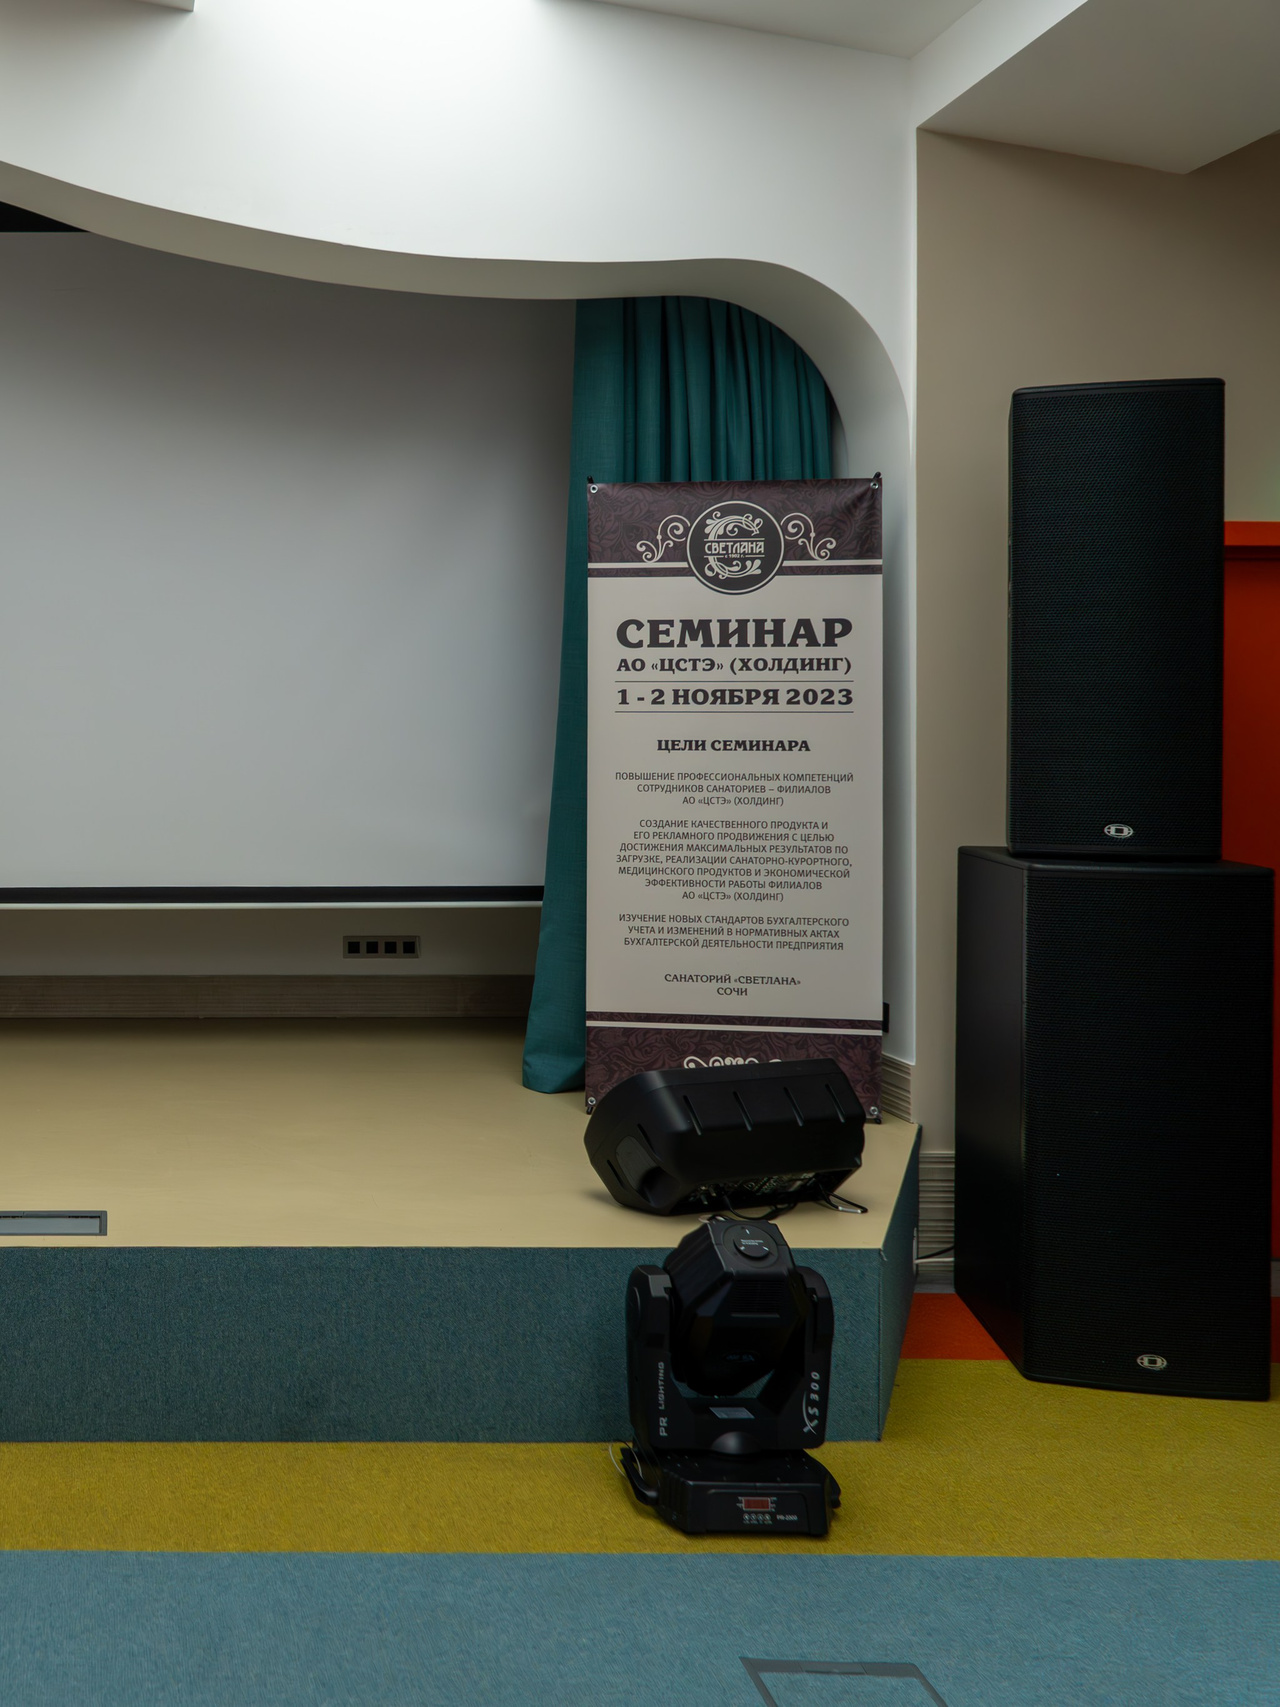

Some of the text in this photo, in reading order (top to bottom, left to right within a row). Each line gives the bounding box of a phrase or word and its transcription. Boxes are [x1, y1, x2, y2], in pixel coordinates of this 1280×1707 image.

[705, 542, 764, 553] СВЕТЛАНА
[615, 617, 853, 649] СЕМИНАР
[615, 656, 852, 676] АО «ЦСТЭ» (ХОЛДИНГ)
[617, 688, 630, 705] 1
[650, 688, 665, 705] 2
[671, 688, 780, 706] НОЯБРЯ
[785, 687, 853, 706] 2023
[656, 739, 811, 754] ЦЕЛИ СЕМИНАРА
[614, 771, 854, 784] ПОВЫШЕНИЕ ПРОФЕССИОНАЛЬНЫХ КОМПЕТЕНЦИЙ
[636, 783, 704, 794] СОТРУДНИКОВ
[705, 784, 766, 794] САНАТОРИЕВ
[776, 784, 831, 794] ФИЛИАЛОВ
[681, 795, 784, 807] АО «ЦСТЭ» (ХОЛДИНГ)
[638, 818, 828, 831] СОЗДАНИЕ КАЧЕСТВЕННОГО ПРОДУКТА И
[633, 830, 835, 843] ЕГО РЕКЛАМНОГО ПРОДВИЖЕНИЯ С ЦЕЛЬЮ
[618, 842, 849, 855] ДОСТИЖЕНИЯ МАКСИМАЛЬНЫХ РЕЗУЛЬТАТОВ ПО
[615, 853, 852, 867] ЗАГРУЗКЕ, РЕАЛИЗАЦИИ САНАТОРНО-КУРОРТНОГО,
[617, 866, 850, 878] МЕДИЦИНСКОГО ПРОДУКТОВ И ЭКОНОМИЧЕСКОЙ
[644, 878, 823, 890] ЭФФЕКТИВНОСТИ РАБОТЫ ФИЛИАЛОВ
[681, 890, 784, 903] АО «ЦСТЭ» (ХОЛДИНГ)
[618, 913, 849, 927] ИЗУЧЕНИЕ НОВЫХ СТАНДАРТОВ БУХГАЛТЕРСКОГО
[627, 925, 840, 939] УЧЕТА И ИЗМЕНЕНИЙ В НОРМАТИВНЫХ АКТАХ
[623, 936, 844, 951] БУХГАЛТЕРСКОЙ ДЕЯТЕЛЬНОСТИ ПРЕДПРИЯТИЯ
[663, 973, 801, 986] САНАТОРИЙ «СВЕТЛАНА»
[716, 986, 748, 996] СОЧИ
[803, 1371, 820, 1434] XS 300
[659, 1416, 668, 1437] PR
